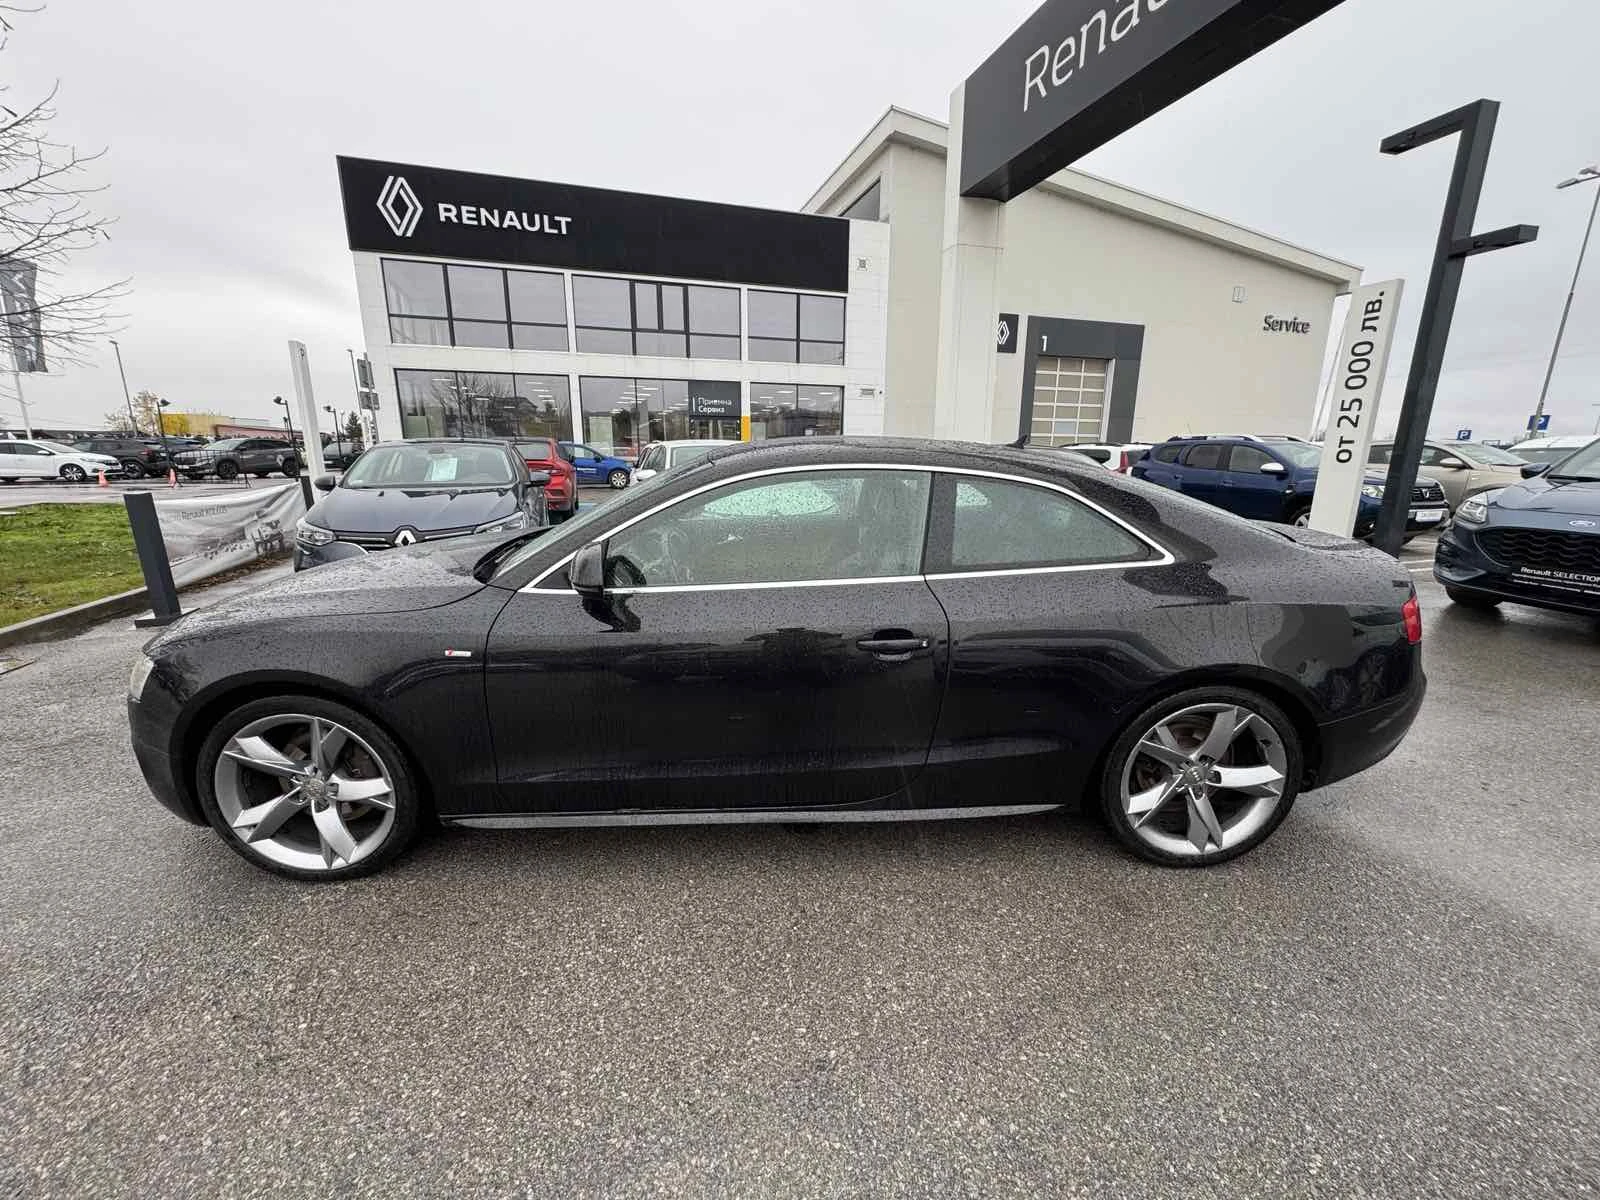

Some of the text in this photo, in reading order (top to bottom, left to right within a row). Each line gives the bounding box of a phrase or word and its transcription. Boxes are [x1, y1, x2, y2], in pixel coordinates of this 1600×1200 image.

[1023, 0, 1169, 112] Rena
[438, 202, 572, 235] RENAULT
[1263, 315, 1311, 334] Service
[1361, 291, 1385, 332] лв.
[1041, 335, 1048, 352] 1
[1345, 340, 1374, 390] 000
[1337, 398, 1363, 428] 25
[1460, 431, 1468, 439] P
[1520, 566, 1551, 577] Renault
